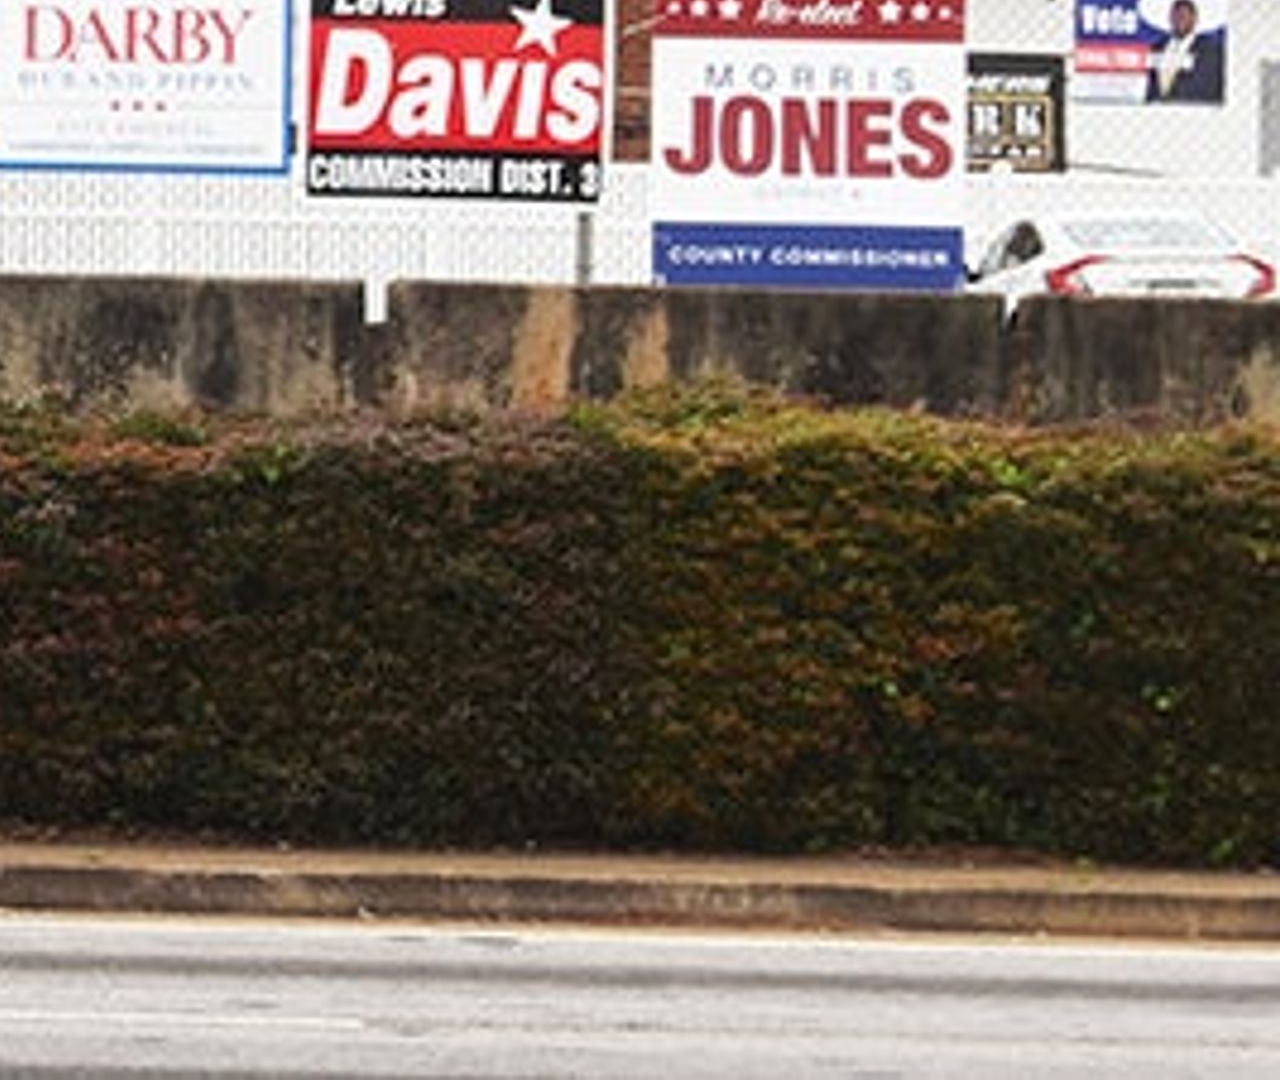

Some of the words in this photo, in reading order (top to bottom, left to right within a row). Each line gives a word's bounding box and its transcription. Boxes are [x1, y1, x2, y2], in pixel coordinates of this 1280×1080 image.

[22, 4, 255, 65] DARBY
[314, 27, 603, 144] Davis
[703, 63, 915, 92] MORRIS
[663, 94, 954, 179] JONES
[309, 154, 494, 192] COMMISSION
[500, 159, 573, 194] DIST.
[667, 244, 762, 266] COUNTY
[769, 247, 949, 268] COMMISSIONER
